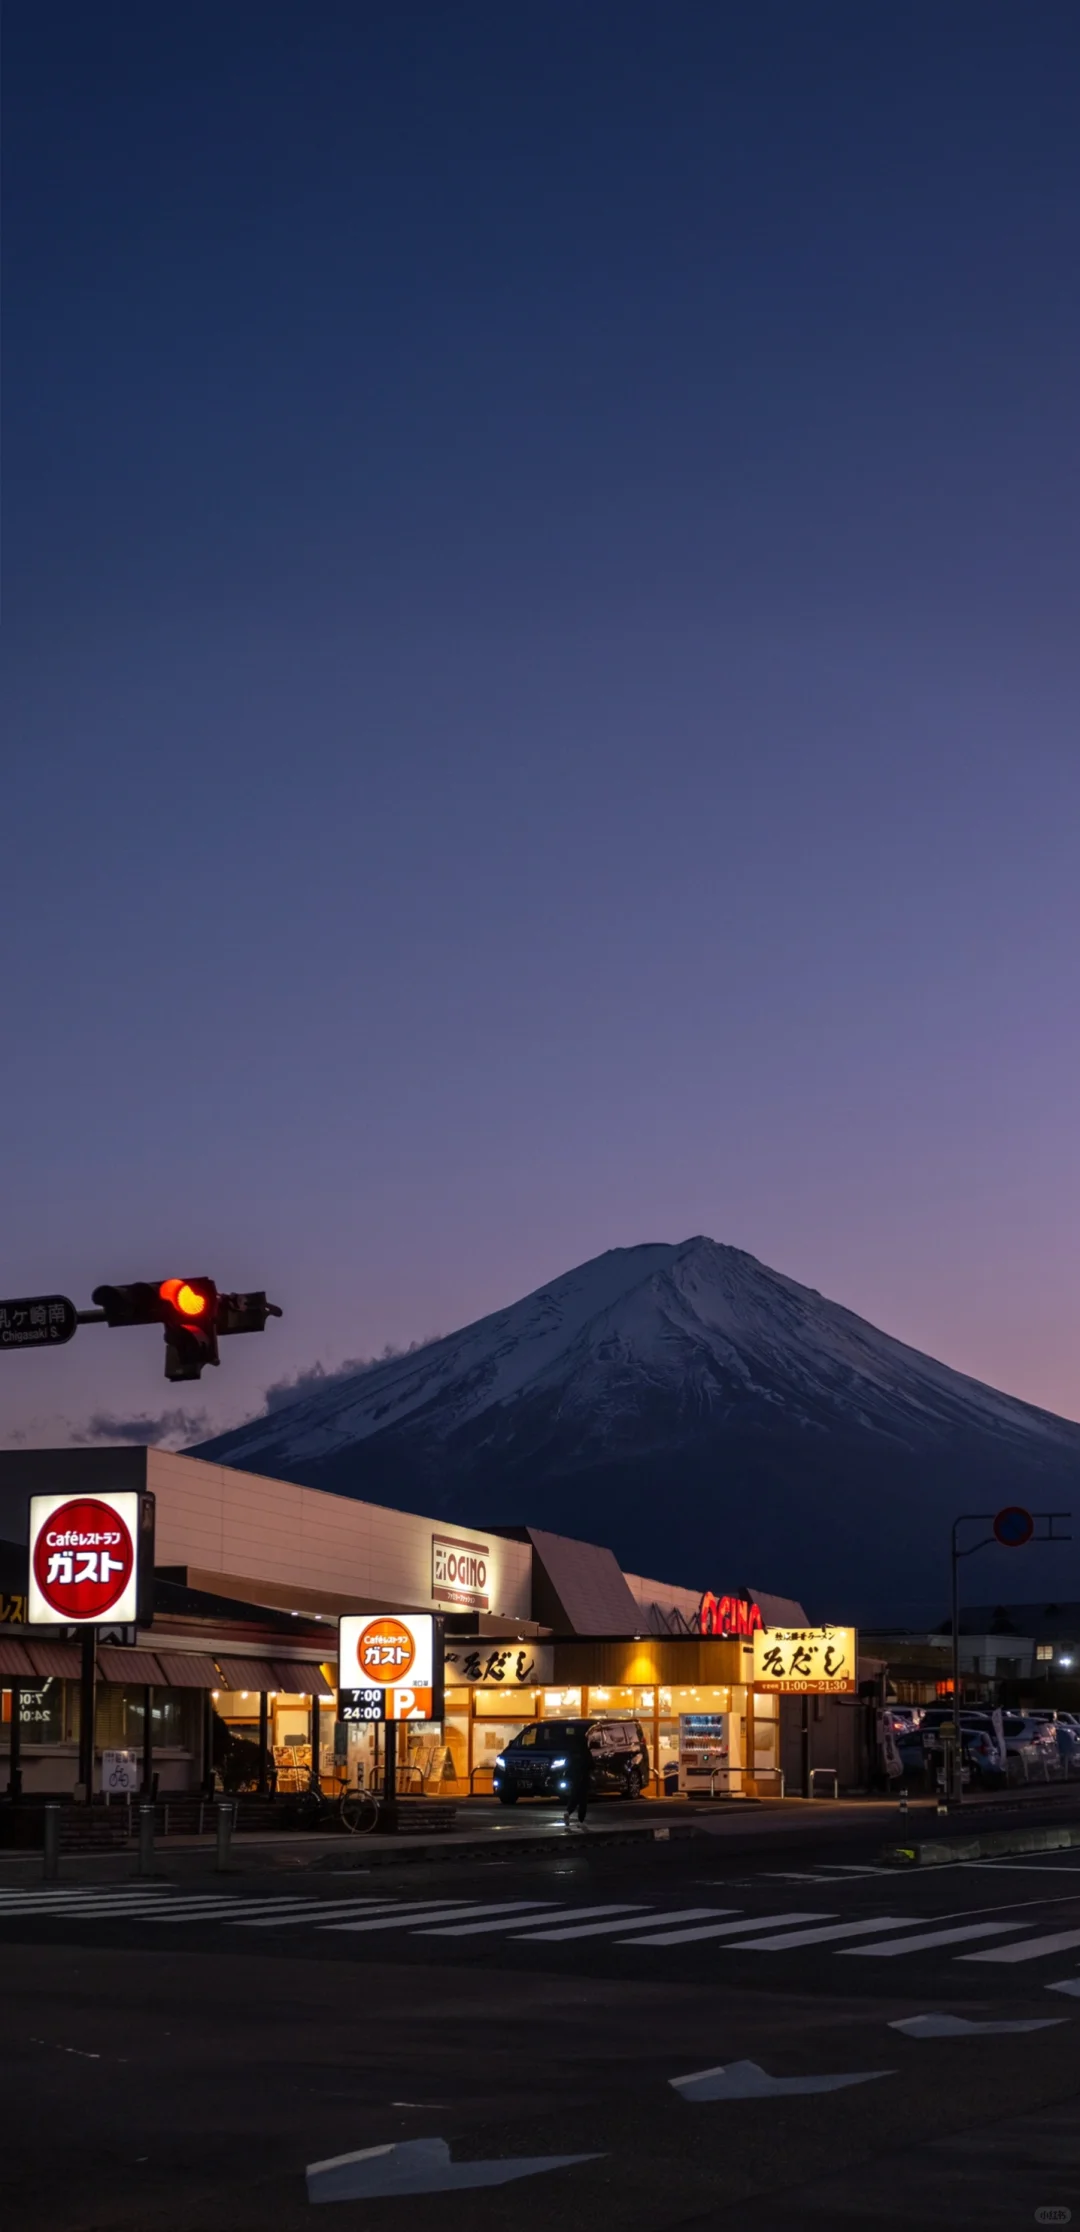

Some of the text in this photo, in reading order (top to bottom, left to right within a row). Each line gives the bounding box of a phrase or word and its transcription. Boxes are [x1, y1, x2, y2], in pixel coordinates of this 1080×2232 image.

[3, 1326, 60, 1343] Chigasaki S.
[46, 1531, 121, 1547] Caféレストラン
[46, 1551, 124, 1584] ガスト
[447, 1553, 487, 1588] OGINO
[364, 1646, 410, 1665] ガスト
[762, 1645, 845, 1677] そだし
[351, 1689, 382, 1702] 7:00
[393, 1688, 416, 1719] P
[343, 1707, 382, 1719] 24:00
